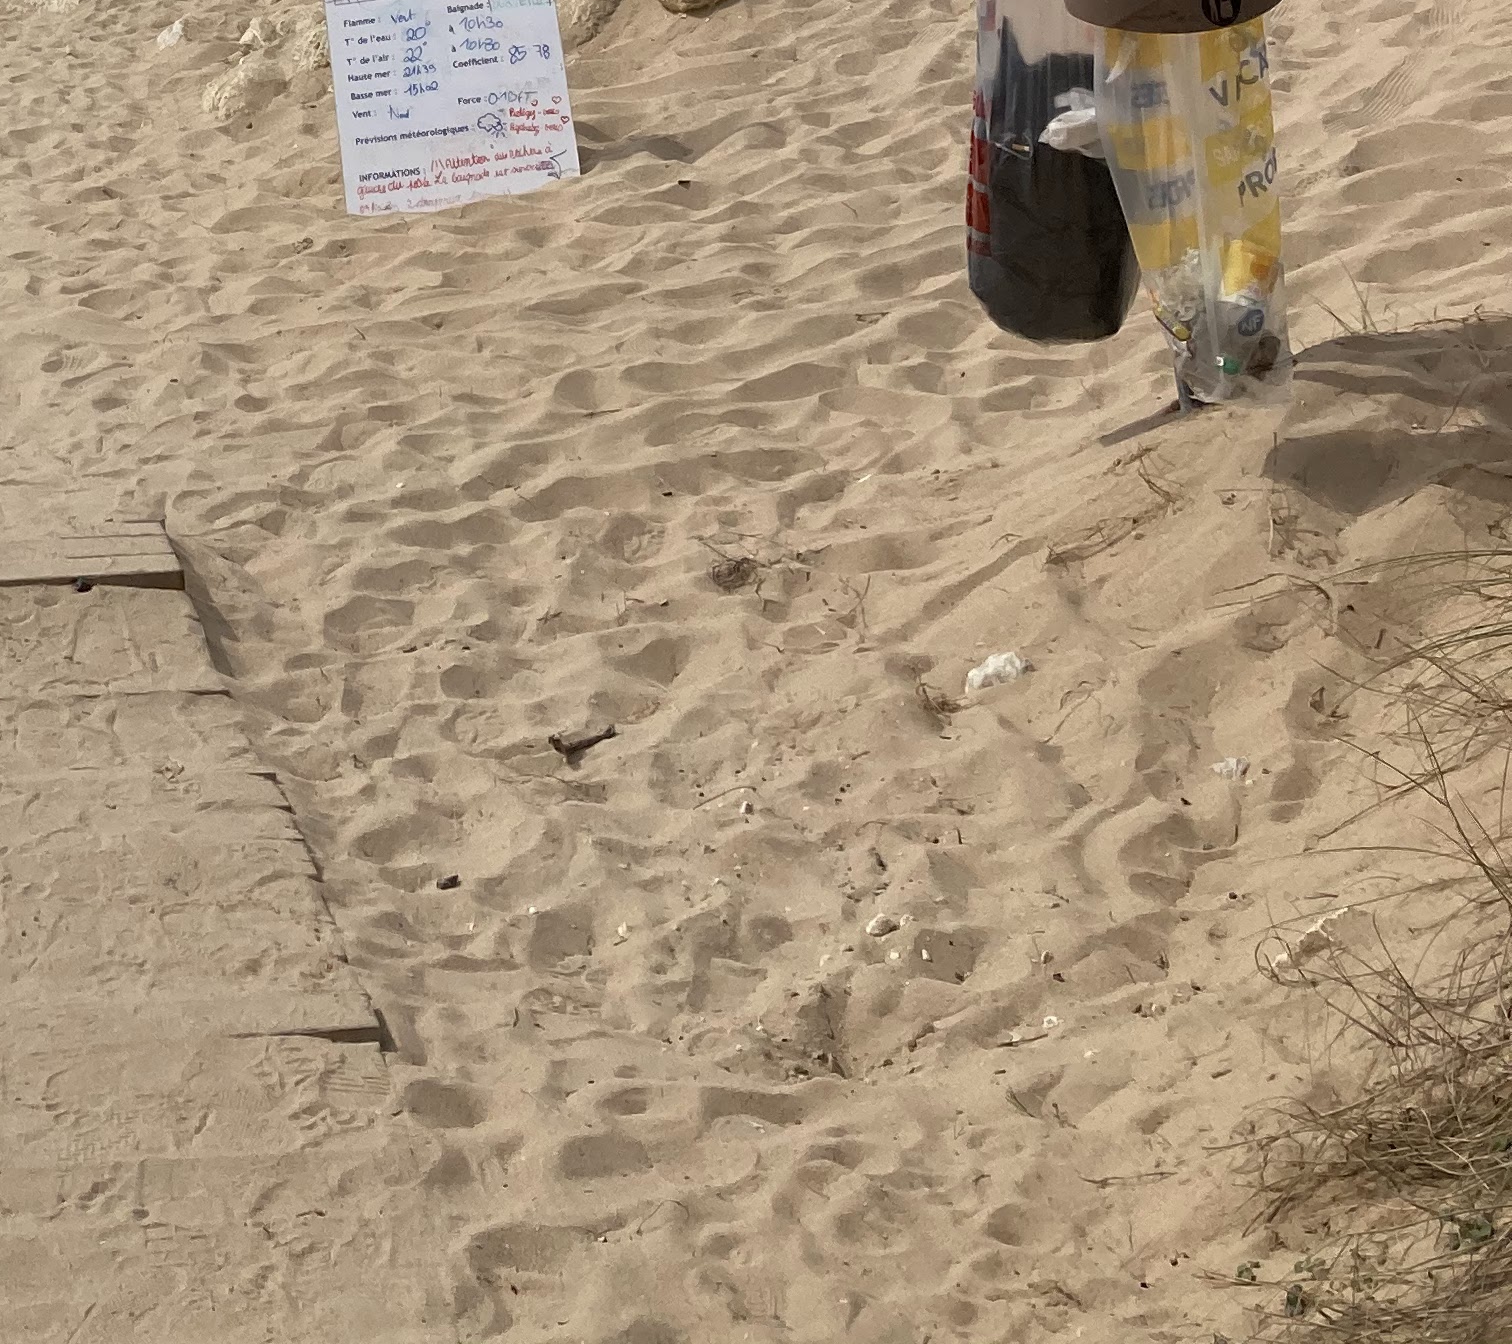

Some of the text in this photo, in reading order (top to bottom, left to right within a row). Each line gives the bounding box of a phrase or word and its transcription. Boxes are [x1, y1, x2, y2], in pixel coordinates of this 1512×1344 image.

[446, 2, 484, 14] Baignade
[343, 17, 376, 28] Flamme
[357, 36, 369, 46] de
[359, 56, 370, 66] de
[452, 55, 499, 69] Coefficient
[347, 72, 373, 83] Haute
[374, 70, 391, 80] mer
[350, 91, 374, 101] Basse
[375, 88, 392, 98] mer
[457, 96, 482, 106] Force
[351, 109, 372, 119] Vent
[355, 133, 398, 146] Prévisions
[399, 124, 469, 140] météorologiques
[358, 166, 421, 183] INFORMATIONS
